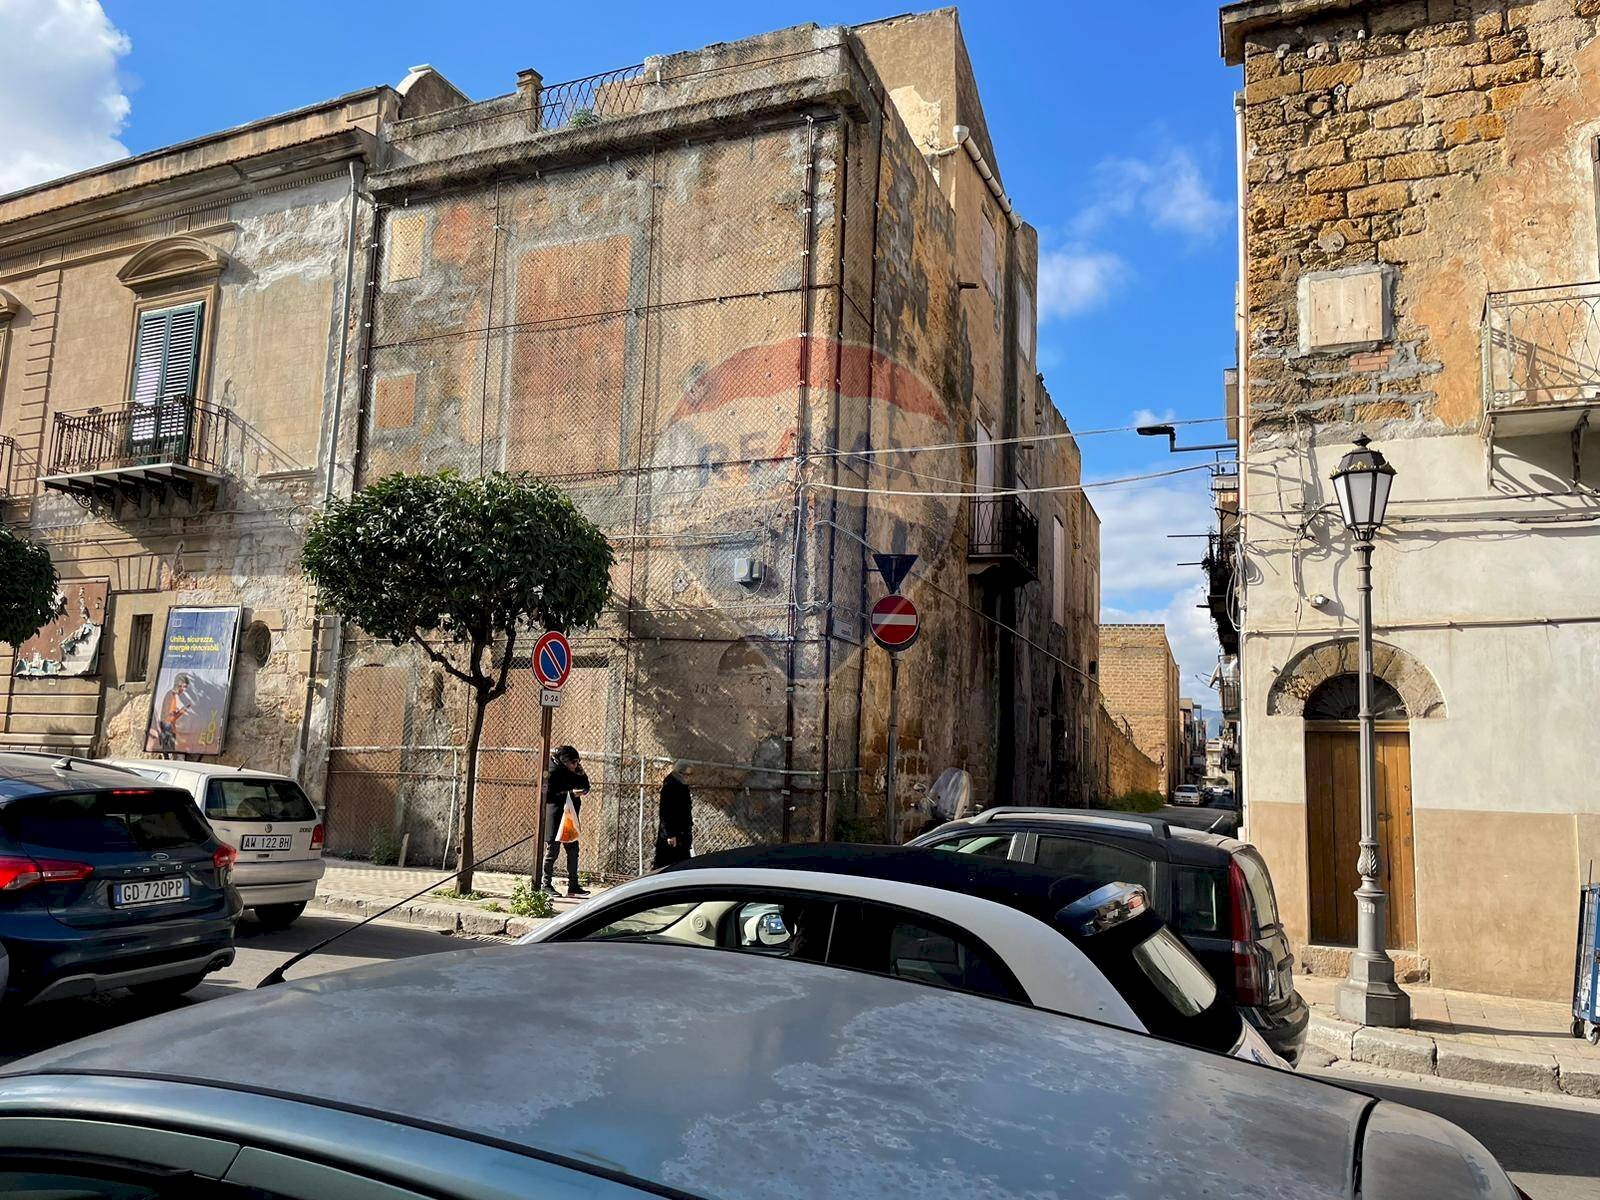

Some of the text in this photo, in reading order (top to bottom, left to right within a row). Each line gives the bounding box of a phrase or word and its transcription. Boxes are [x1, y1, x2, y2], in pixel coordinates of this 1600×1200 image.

[244, 837, 290, 848] AW 122 BH
[123, 884, 140, 901] GD
